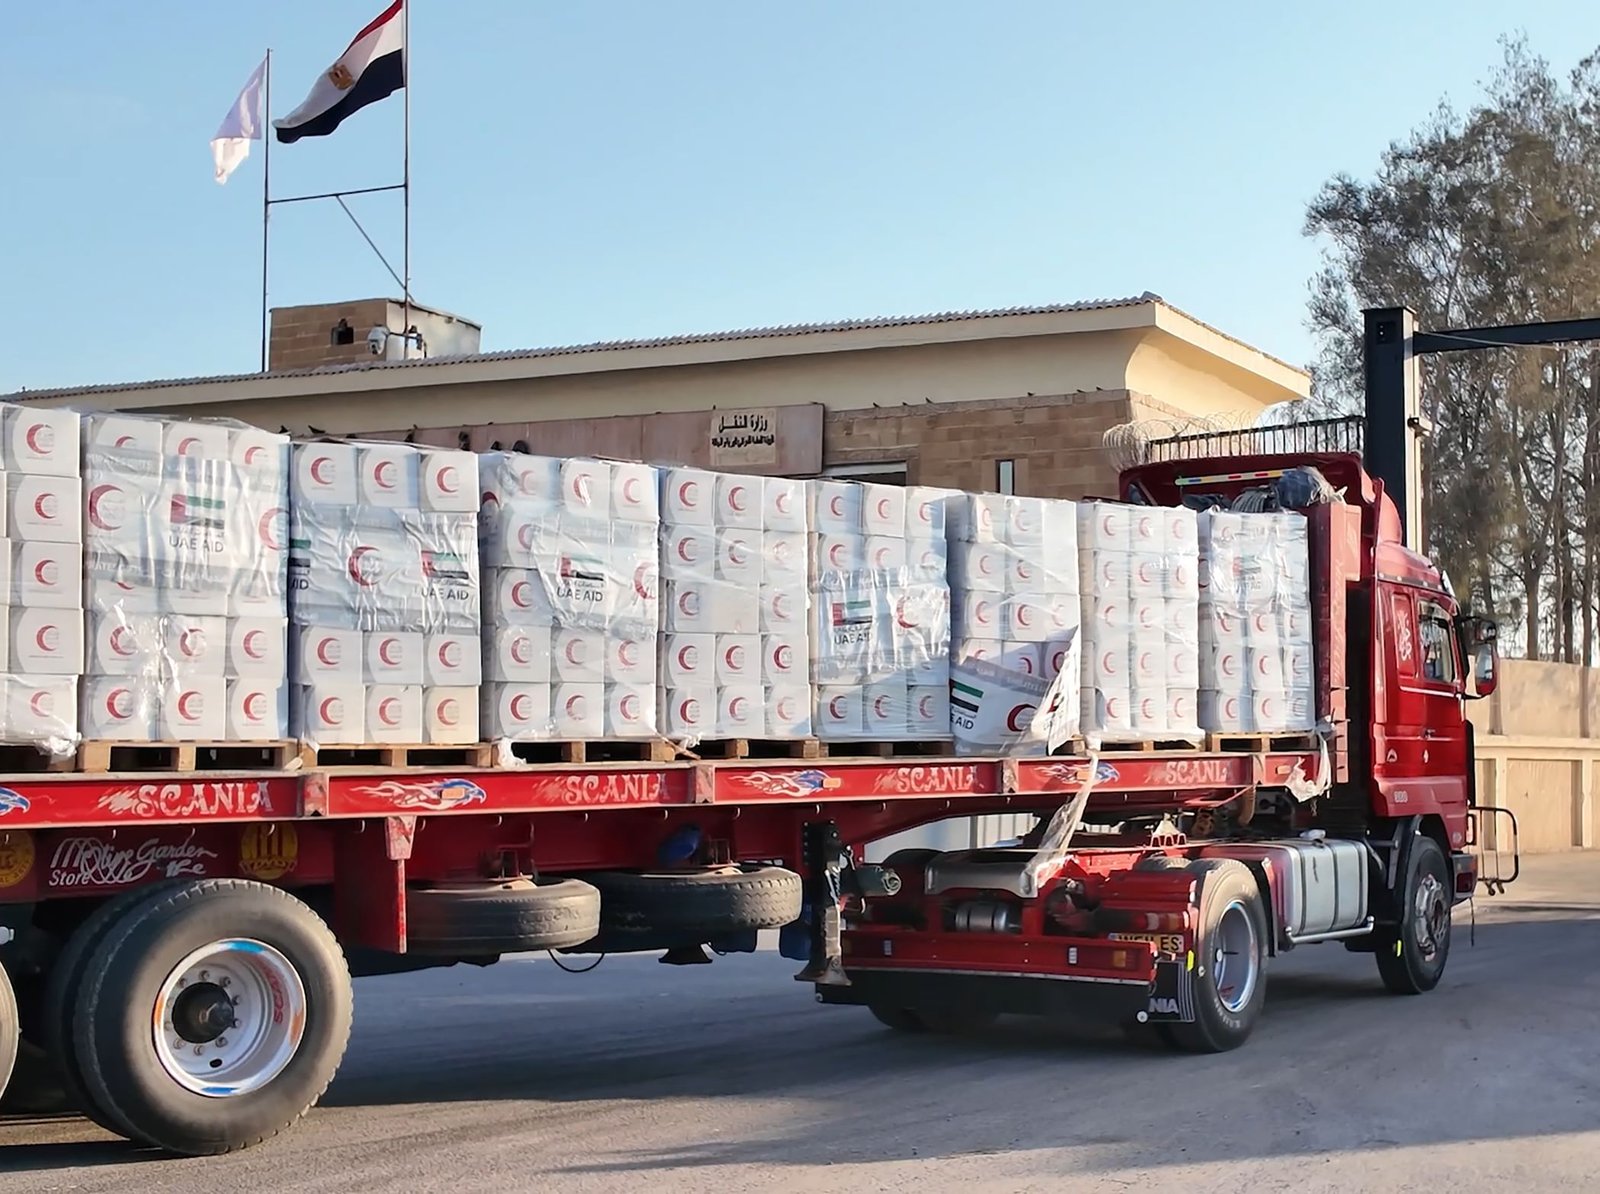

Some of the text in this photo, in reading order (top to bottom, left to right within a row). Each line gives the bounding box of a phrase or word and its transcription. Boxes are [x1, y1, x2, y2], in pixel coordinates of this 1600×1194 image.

[169, 536, 224, 552] UAE AID
[447, 589, 469, 600] AID
[557, 587, 603, 602] UAE AID
[834, 633, 855, 645] UAE
[955, 716, 974, 730] AID
[565, 773, 670, 804] SCANIA
[134, 781, 274, 817] SCANIA
[49, 869, 90, 886] Store
